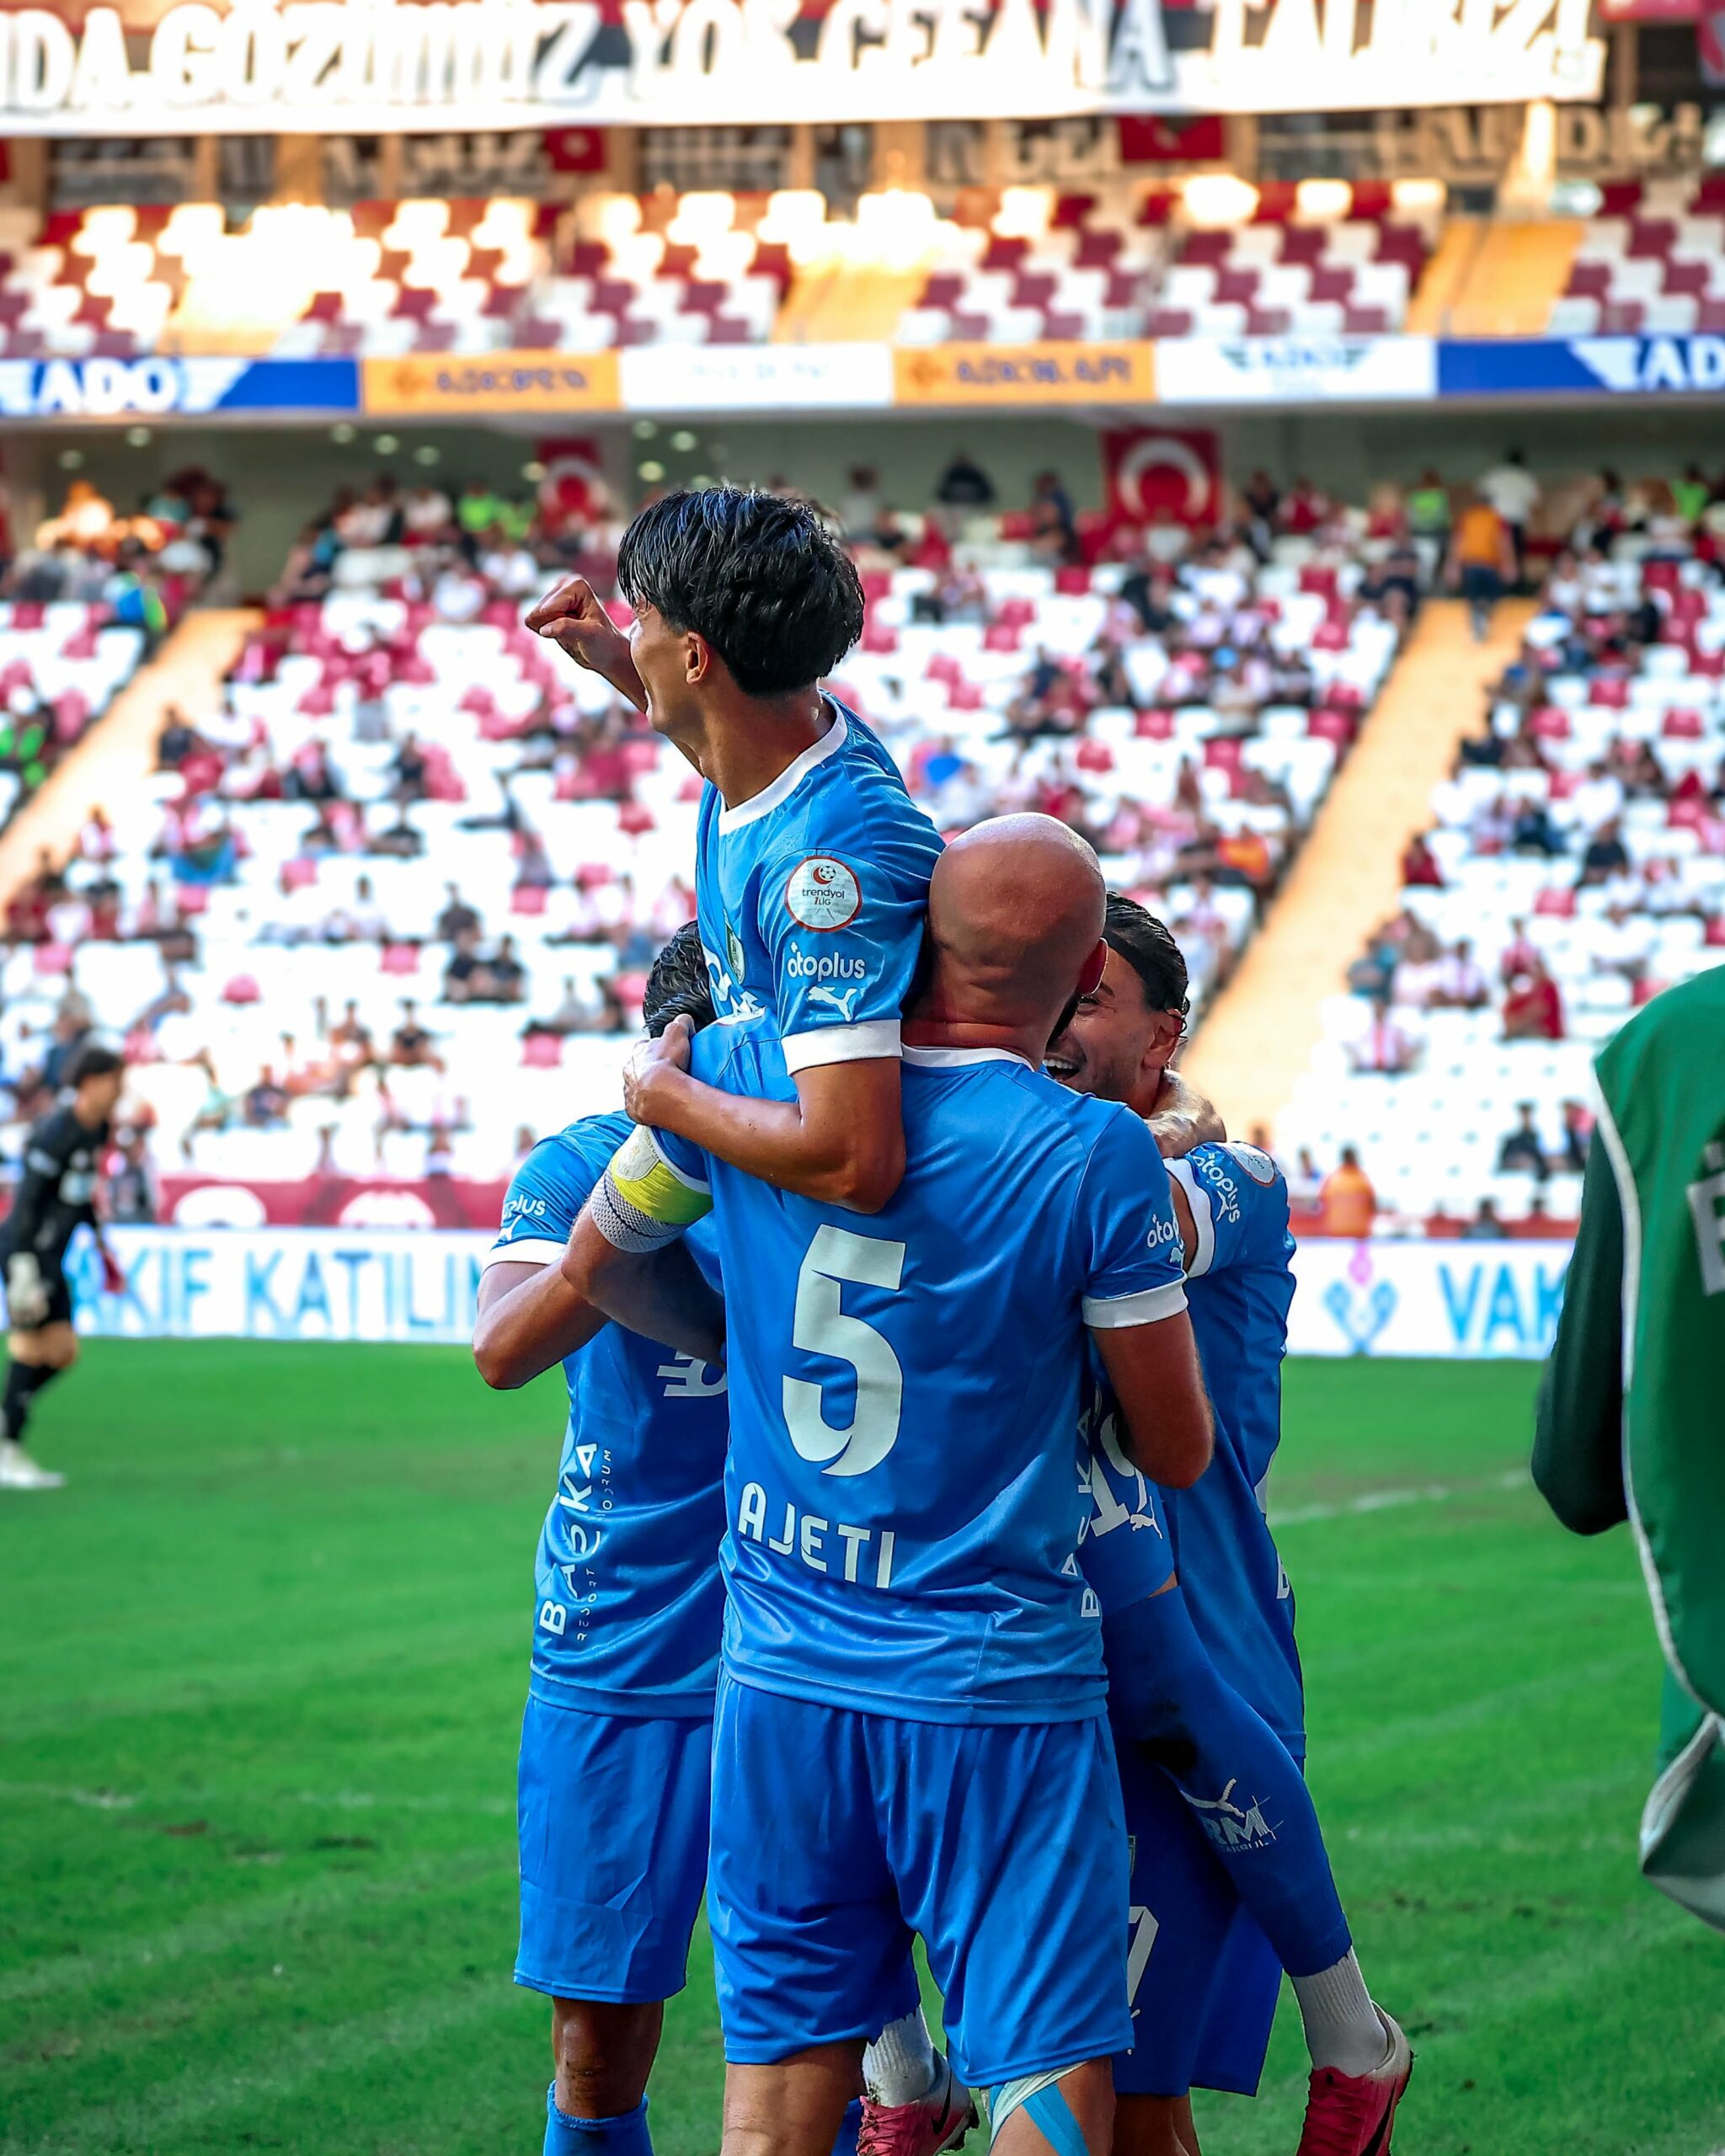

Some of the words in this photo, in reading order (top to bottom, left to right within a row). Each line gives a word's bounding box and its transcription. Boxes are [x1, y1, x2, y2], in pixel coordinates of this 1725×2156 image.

[39, 360, 179, 413] ADO
[802, 889, 845, 899] trendyol
[788, 942, 865, 981] otoplus
[782, 1224, 906, 1477] 5
[738, 1482, 895, 1589] AJETI
